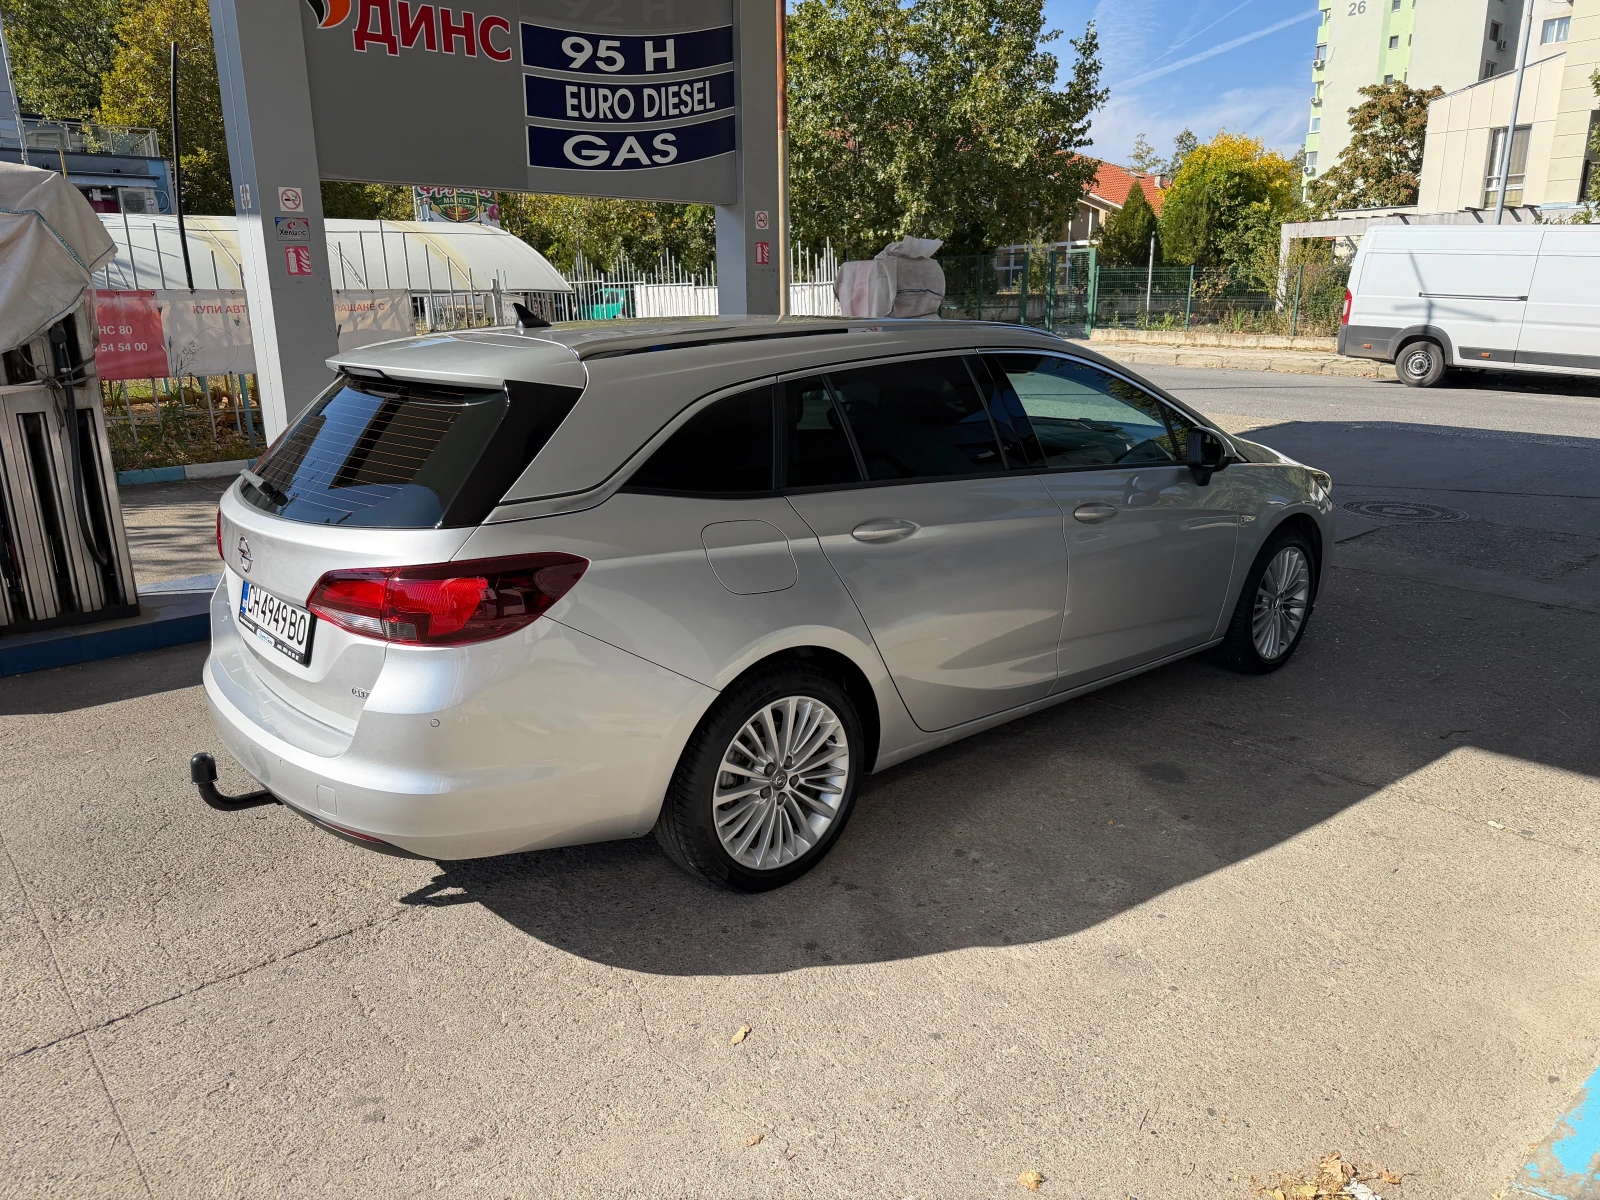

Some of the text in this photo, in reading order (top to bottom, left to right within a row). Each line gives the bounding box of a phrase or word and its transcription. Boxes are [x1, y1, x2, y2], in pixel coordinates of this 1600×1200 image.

[1348, 0, 1367, 17] 26
[352, 0, 512, 62] ДИНС
[561, 36, 676, 73] 95 H
[565, 80, 716, 120] EURO DIESEL
[562, 132, 678, 167] GAS
[192, 305, 222, 314] КУПИ
[378, 302, 385, 311] С
[118, 325, 133, 335] 80
[101, 343, 114, 352] 54
[118, 343, 131, 352] 54
[134, 342, 148, 351] 00
